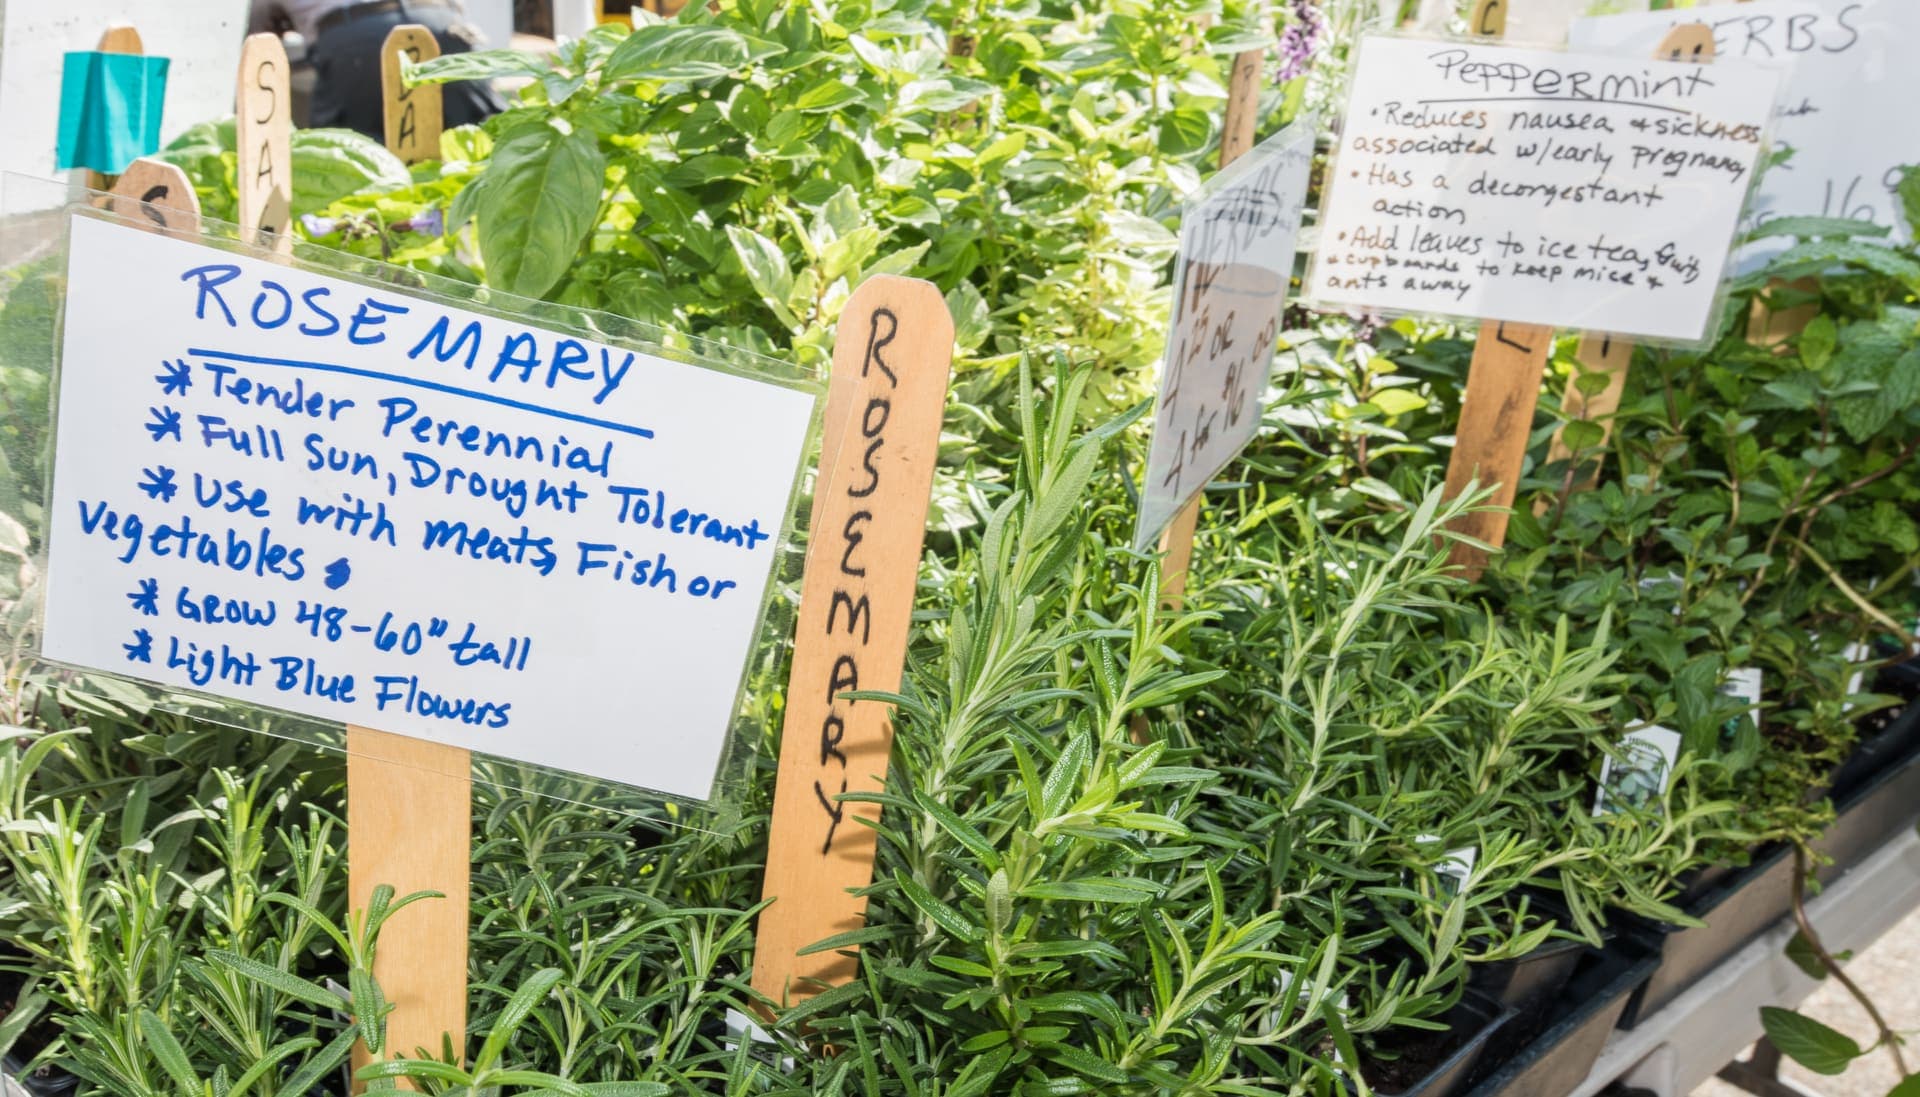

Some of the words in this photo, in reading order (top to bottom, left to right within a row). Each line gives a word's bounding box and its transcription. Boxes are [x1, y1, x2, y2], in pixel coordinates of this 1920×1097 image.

[1672, 4, 1862, 57] ERBS
[1384, 101, 1488, 129] Reduces
[1508, 111, 1614, 134] nausea
[1352, 133, 1496, 155] associated
[1368, 162, 1413, 188] Has
[1432, 174, 1450, 190] a
[1372, 199, 1466, 225] action
[1350, 224, 1399, 251] Add
[1409, 224, 1484, 255] leaves
[1497, 231, 1525, 258] to
[1538, 236, 1578, 260] ice
[1327, 272, 1388, 290] ants
[1403, 277, 1471, 302] away
[1476, 260, 1500, 277] to
[1511, 264, 1562, 283] keep
[1573, 266, 1635, 286] mice
[181, 263, 635, 404] ROSEMARY
[203, 362, 355, 420] Tender
[378, 397, 614, 478] Perennial
[197, 413, 284, 462] Full
[304, 431, 397, 497] Sun,
[402, 451, 588, 518] Drought
[608, 484, 770, 550] Tolerant
[78, 499, 305, 582] Vegetables
[193, 472, 270, 518] Use
[297, 492, 397, 547] with
[576, 540, 676, 593] Fish
[687, 574, 737, 600] or
[814, 307, 899, 857] ROSEMARY
[448, 621, 531, 672] tall
[165, 635, 262, 686] Light
[270, 656, 357, 704] Blue
[374, 675, 512, 729] Flowers
